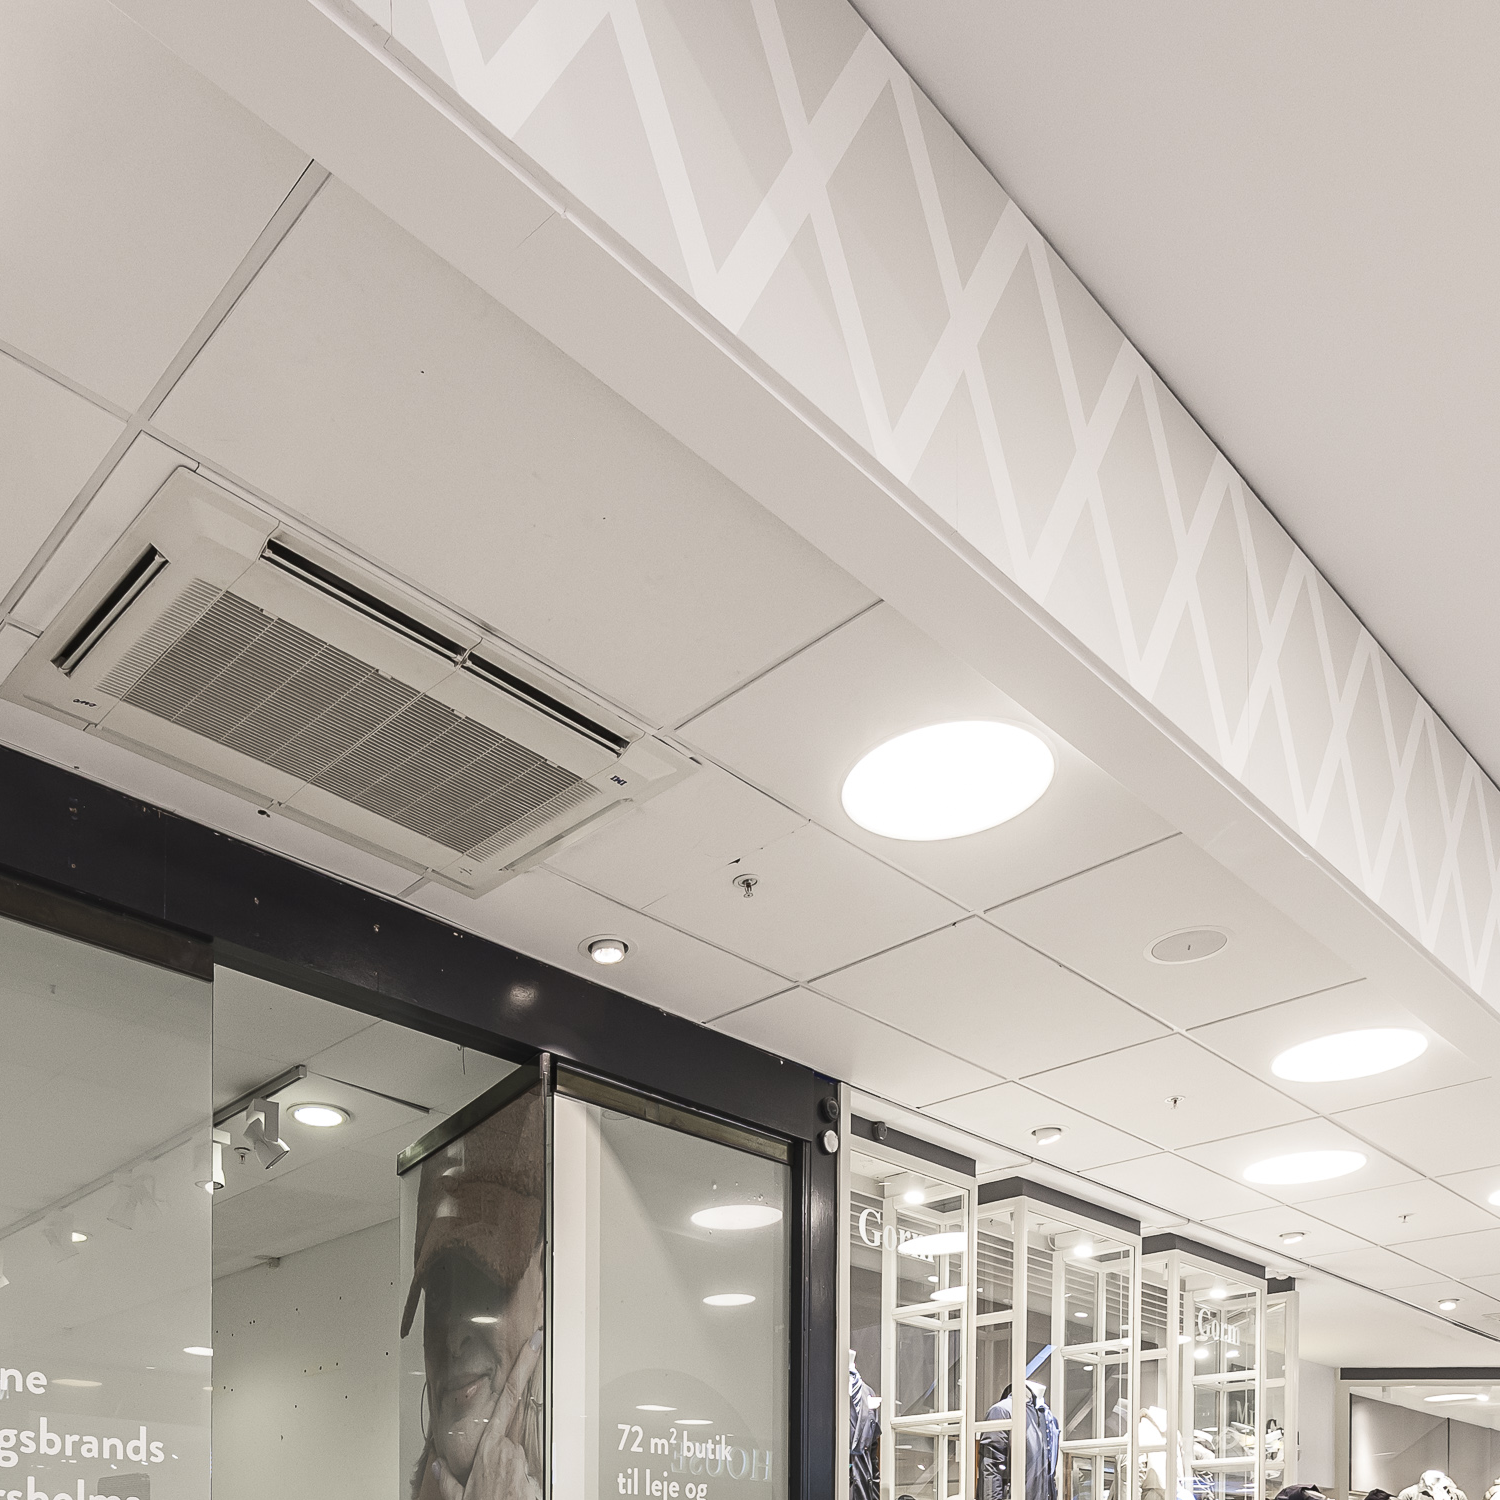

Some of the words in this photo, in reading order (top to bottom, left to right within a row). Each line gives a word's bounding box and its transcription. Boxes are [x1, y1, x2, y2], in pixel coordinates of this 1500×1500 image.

[1198, 1308, 1240, 1346] Gorm
[617, 1424, 644, 1453] 72
[682, 1431, 733, 1461] butik
[617, 1468, 639, 1495] til
